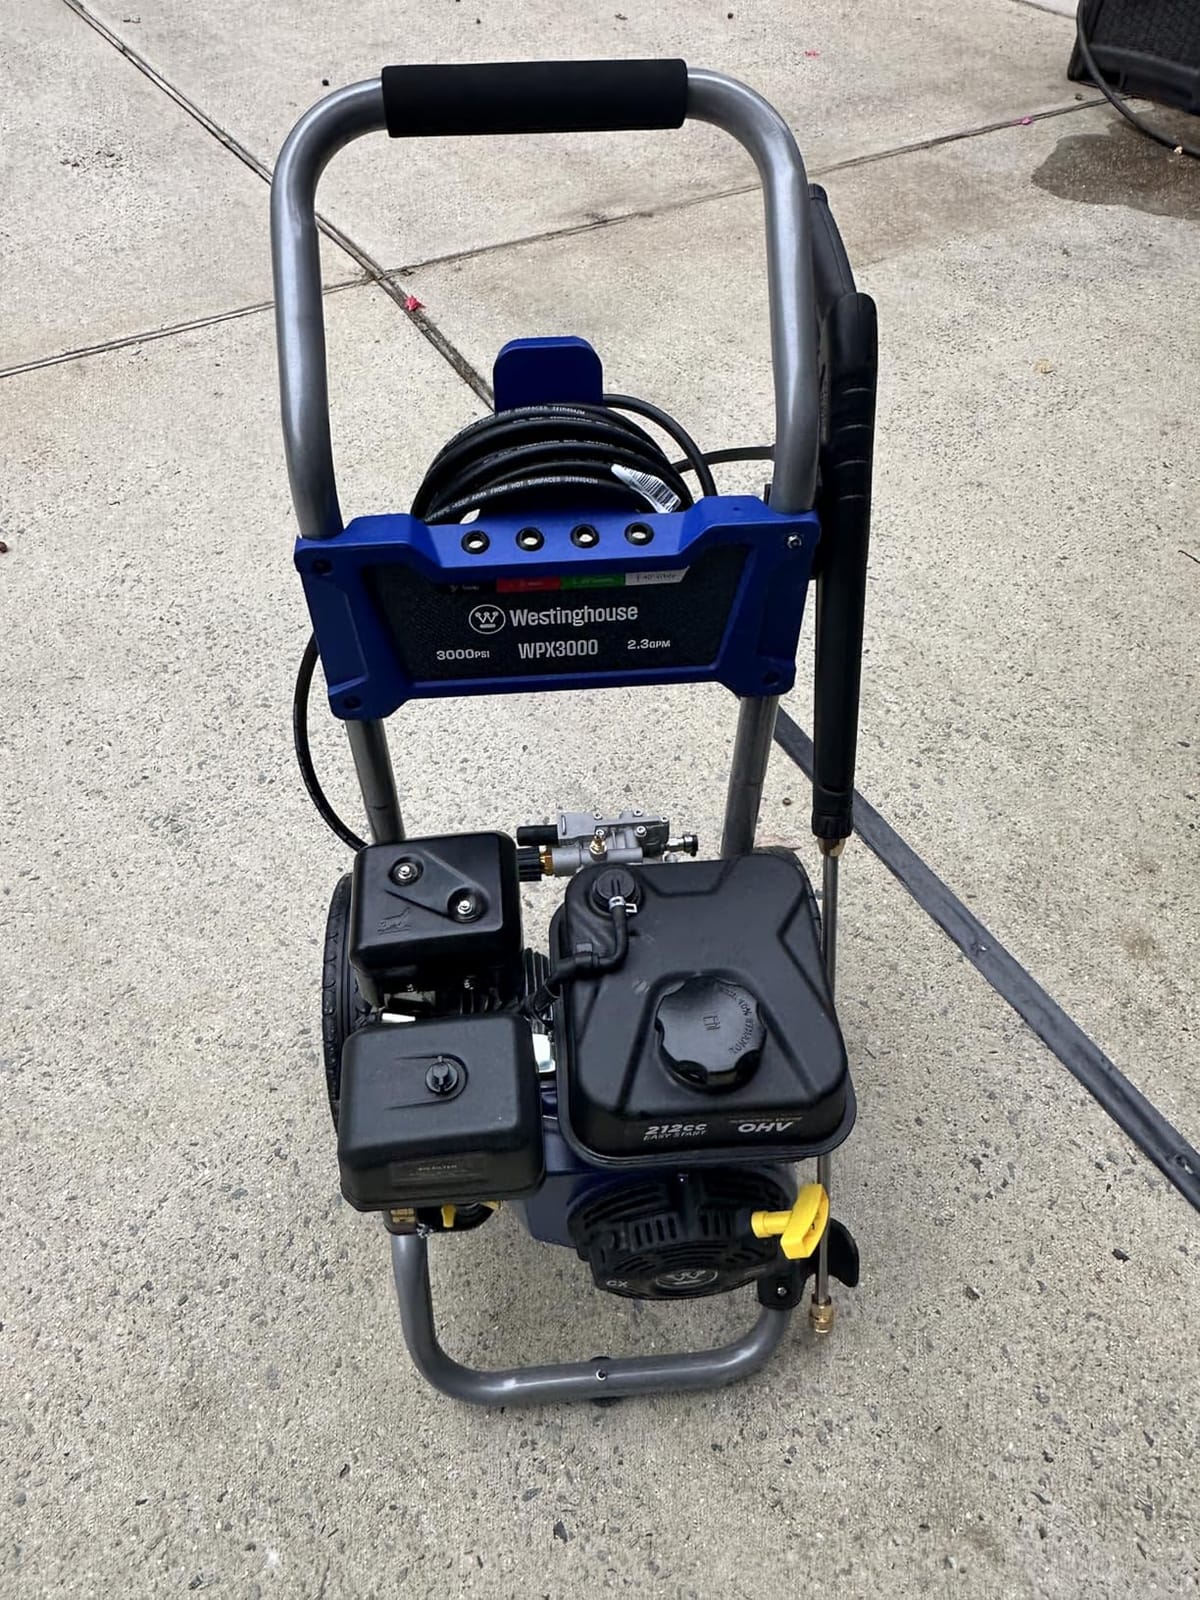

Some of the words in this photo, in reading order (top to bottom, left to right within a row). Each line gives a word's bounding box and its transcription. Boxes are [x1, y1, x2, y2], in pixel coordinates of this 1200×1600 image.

[490, 485, 508, 495] FROM
[511, 481, 524, 489] HOT
[528, 476, 561, 486] SURFACES
[509, 604, 639, 627] Westinghouse
[517, 639, 599, 660] WPX3000
[642, 1132, 671, 1141] EASY
[673, 1130, 707, 1139] START
[738, 1120, 794, 1133] OHV
